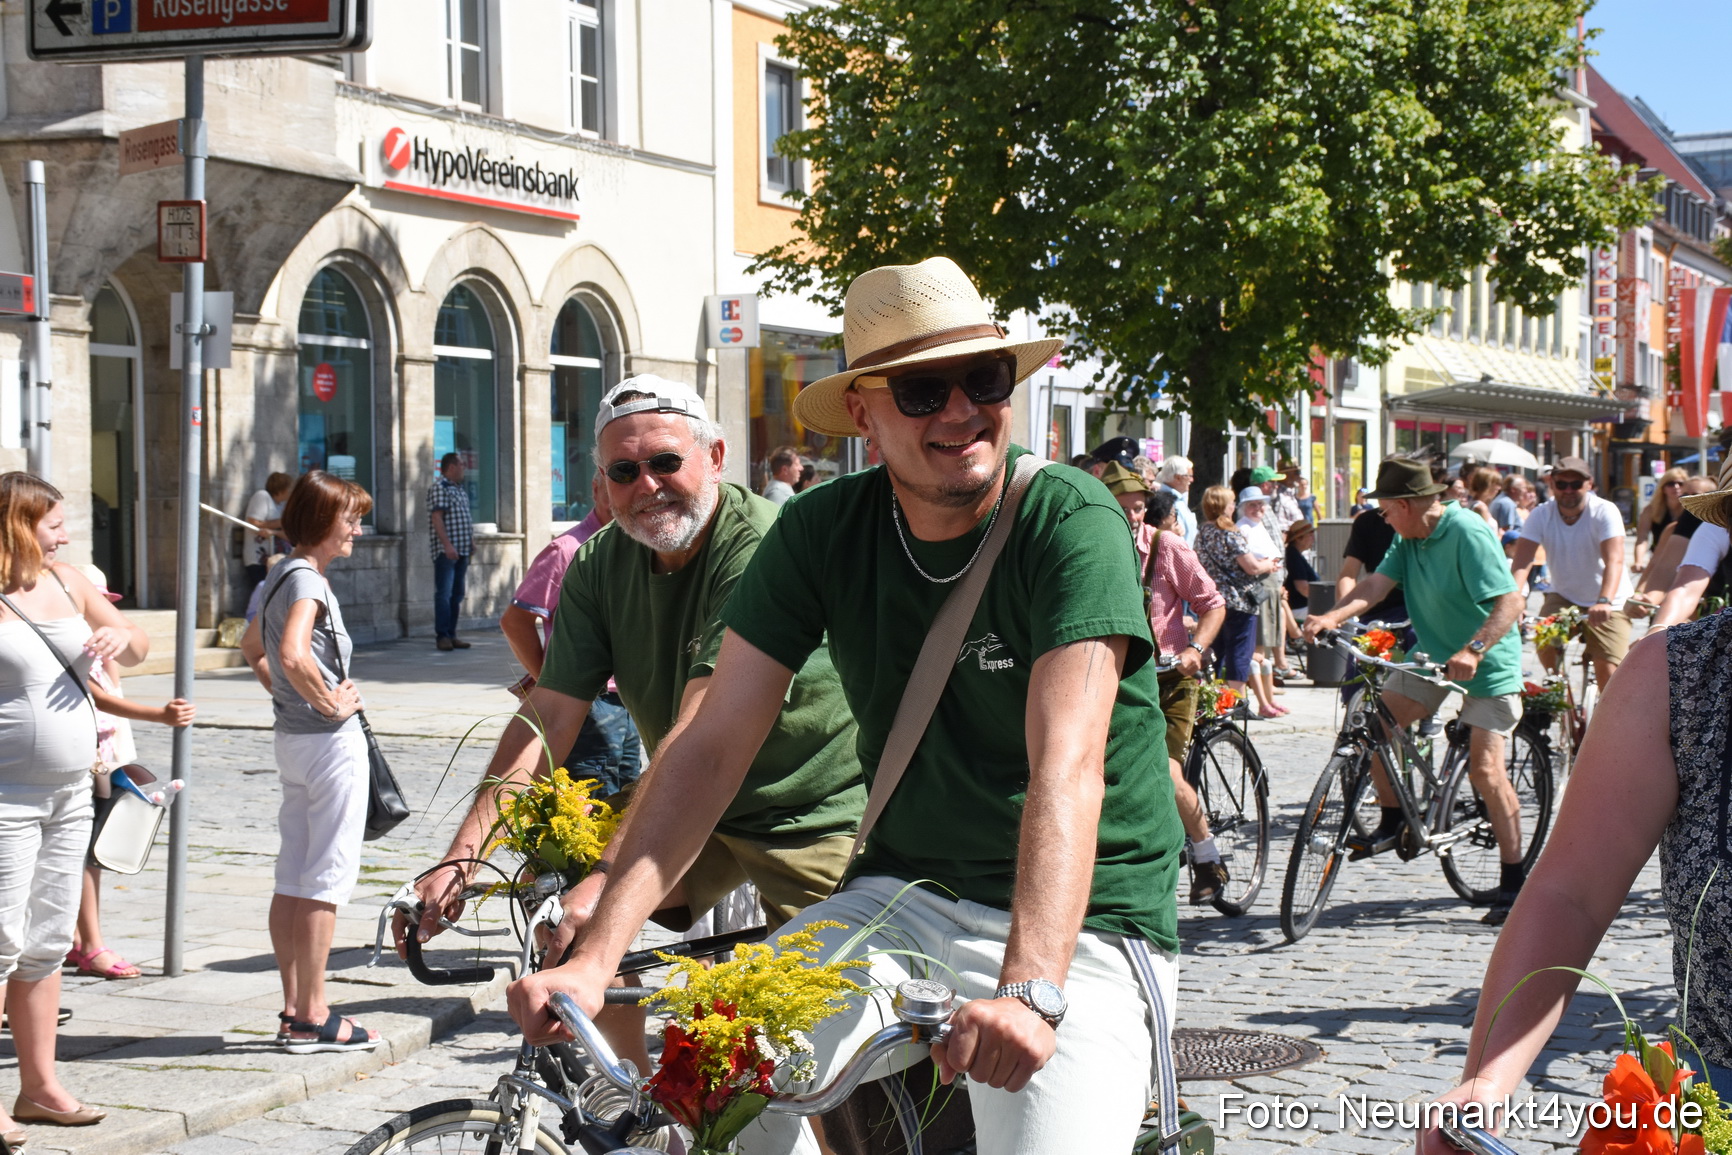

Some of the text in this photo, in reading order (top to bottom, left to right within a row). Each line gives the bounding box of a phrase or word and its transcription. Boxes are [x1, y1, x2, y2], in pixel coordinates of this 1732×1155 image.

[153, 0, 288, 23] Rosengasse
[125, 135, 176, 165] Rosengass
[414, 135, 580, 201] HypoVereinsbank
[721, 299, 741, 321] EC
[1598, 247, 1611, 354] CKEREI
